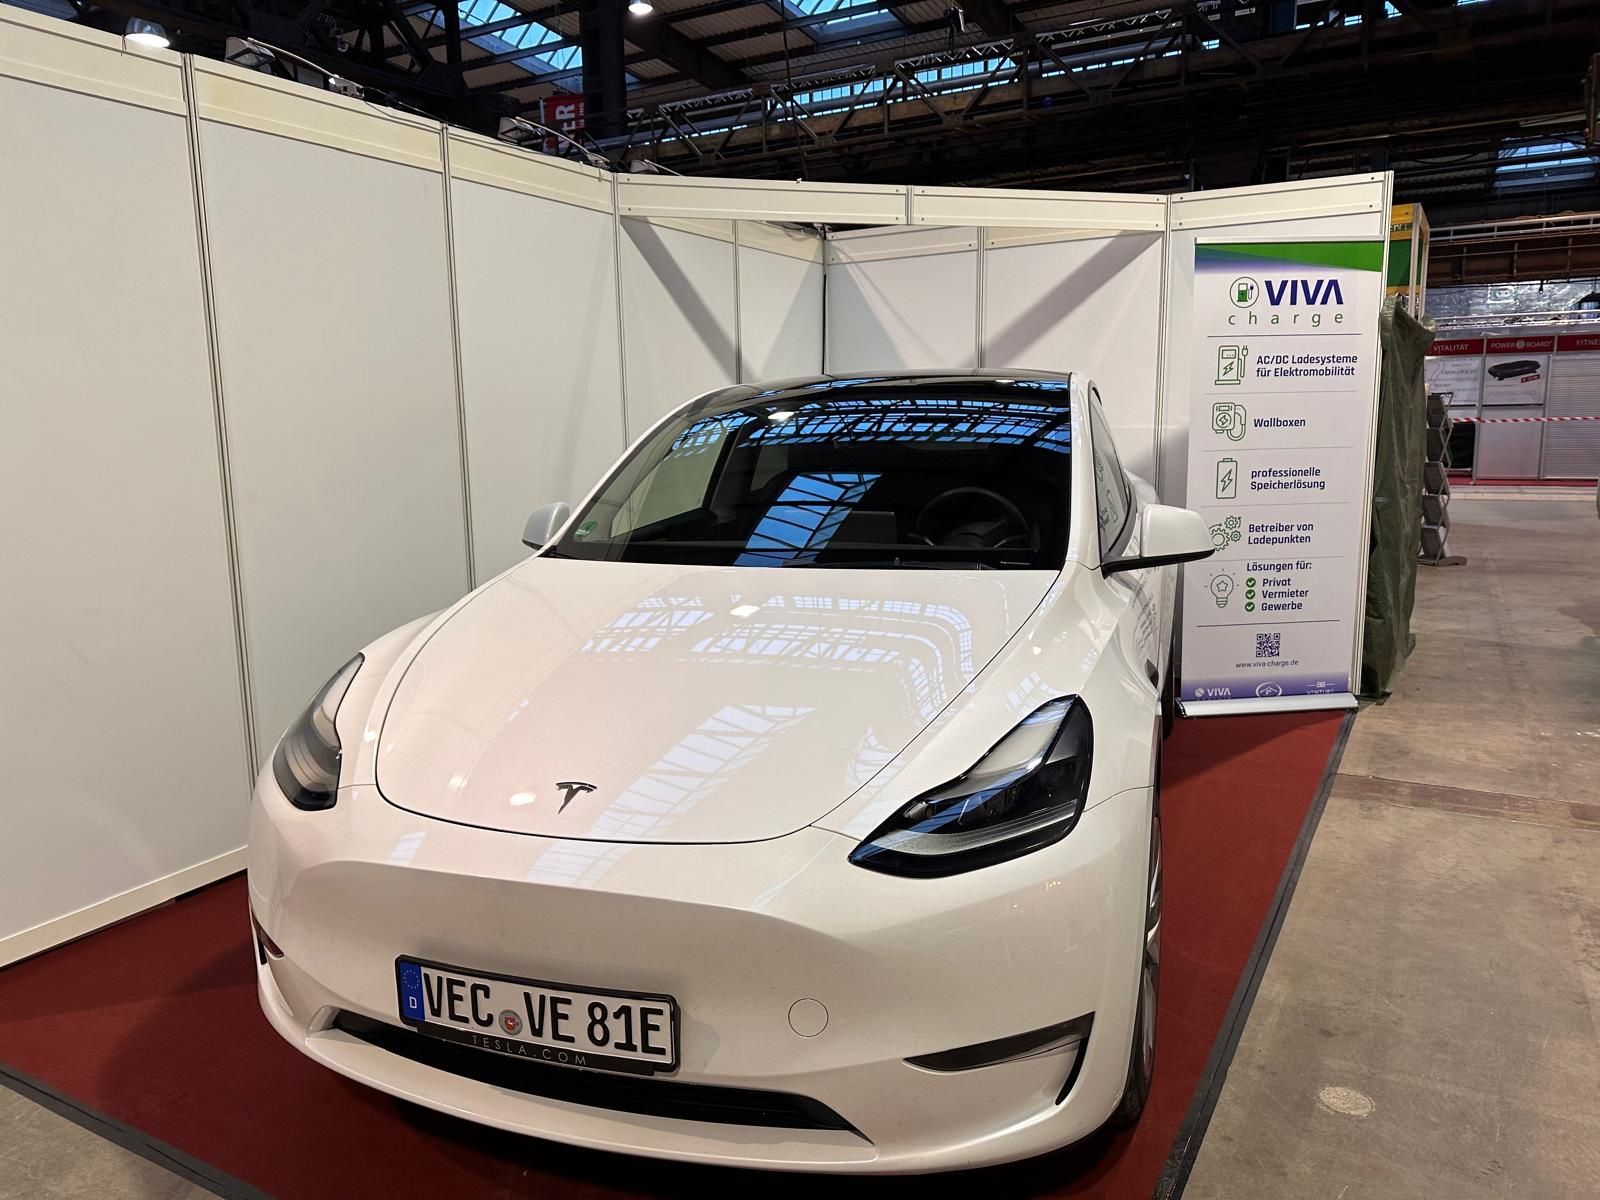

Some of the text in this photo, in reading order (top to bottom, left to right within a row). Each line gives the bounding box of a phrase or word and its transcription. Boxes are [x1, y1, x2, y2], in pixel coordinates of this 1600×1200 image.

[1264, 279, 1344, 306] VIVA
[1228, 311, 1344, 328] charge
[1256, 354, 1358, 366] AC/DC Ladesysteme
[1256, 366, 1355, 378] für Elektromobilität
[1253, 417, 1306, 428] Wallboxen
[1250, 467, 1321, 480] professionelle
[1250, 480, 1326, 491] Speicherlösung
[1248, 523, 1314, 533] Betreiber von
[1247, 534, 1311, 545] Ladepunkten
[1246, 561, 1312, 573] Lösungen für:
[1262, 578, 1292, 588] Privat
[1261, 589, 1309, 599] Vermieter
[1261, 601, 1303, 612] Gewerbe
[1235, 659, 1299, 669] www.viva-charge.de
[1207, 687, 1232, 697] VIVA
[409, 996, 417, 1009] D
[423, 972, 667, 1056] VEC VE 81E
[472, 1035, 587, 1066] TESLA.COM
